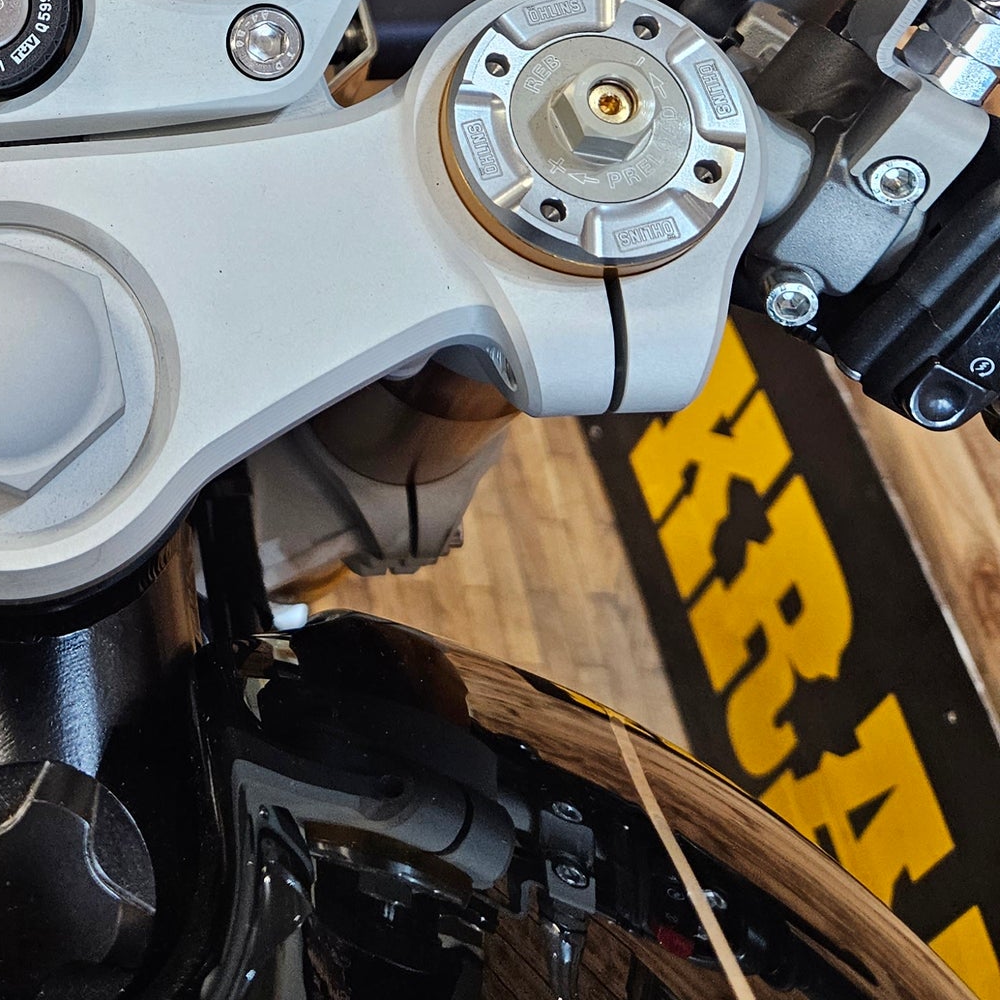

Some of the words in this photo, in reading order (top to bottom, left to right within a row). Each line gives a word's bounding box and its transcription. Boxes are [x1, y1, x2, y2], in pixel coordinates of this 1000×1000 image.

[11, 34, 40, 64] TÜV
[523, 53, 562, 94] REB
[607, 106, 677, 189] PRELOAD
